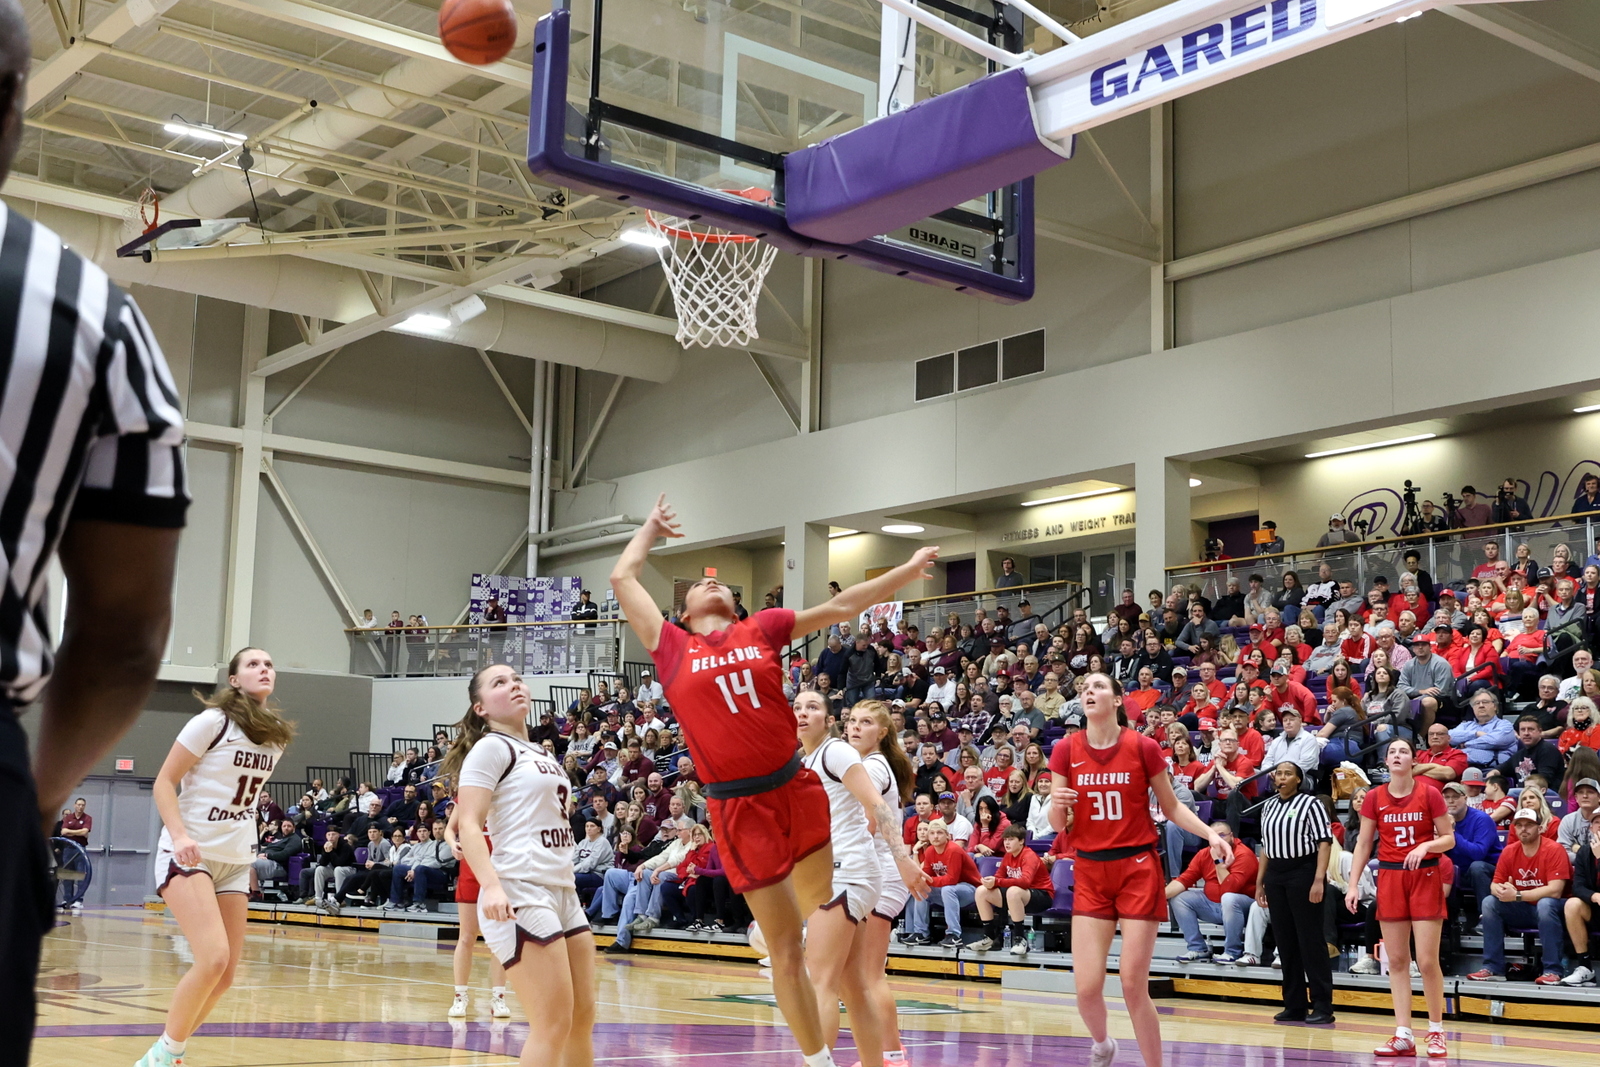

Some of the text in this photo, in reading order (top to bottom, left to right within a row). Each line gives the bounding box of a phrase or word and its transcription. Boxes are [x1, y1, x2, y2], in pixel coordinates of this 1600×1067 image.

[1090, 0, 1317, 106] GARED
[1003, 527, 1039, 541] FITNESS
[1045, 524, 1064, 536] AND
[1070, 517, 1106, 532] WEIGHT
[691, 646, 763, 673] BELLEVUE
[715, 668, 762, 714] 14
[233, 750, 273, 771] GENOA
[231, 775, 265, 806] 15
[1077, 772, 1130, 786] BELLEVUE
[1087, 791, 1123, 820] 30
[1383, 811, 1423, 823] BELLEVUE
[1393, 825, 1416, 847] 21
[1515, 879, 1545, 887] BASEBALL
